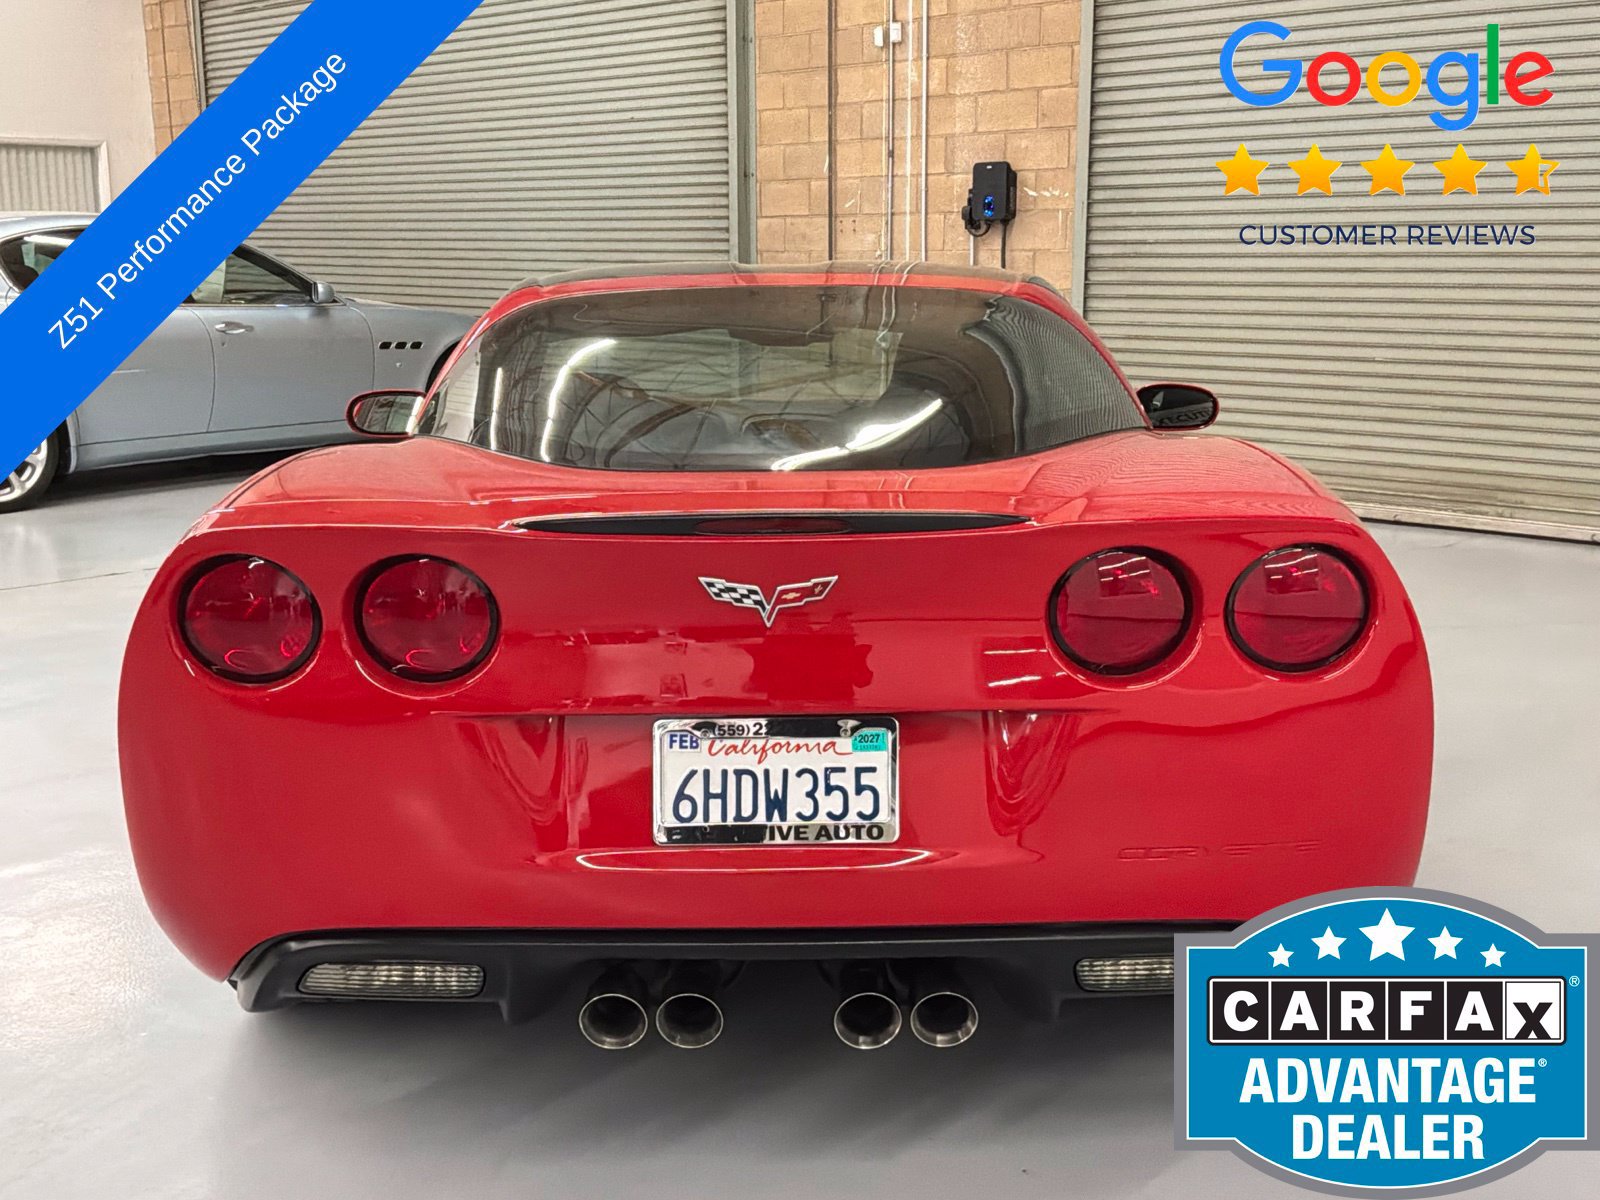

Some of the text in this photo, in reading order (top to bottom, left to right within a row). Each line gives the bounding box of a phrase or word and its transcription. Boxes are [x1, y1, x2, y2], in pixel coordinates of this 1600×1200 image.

[669, 734, 699, 749] FEB
[858, 734, 880, 743] 2027
[708, 739, 853, 764] California
[672, 767, 880, 822] 6HDW355
[814, 825, 884, 840] AUTO
